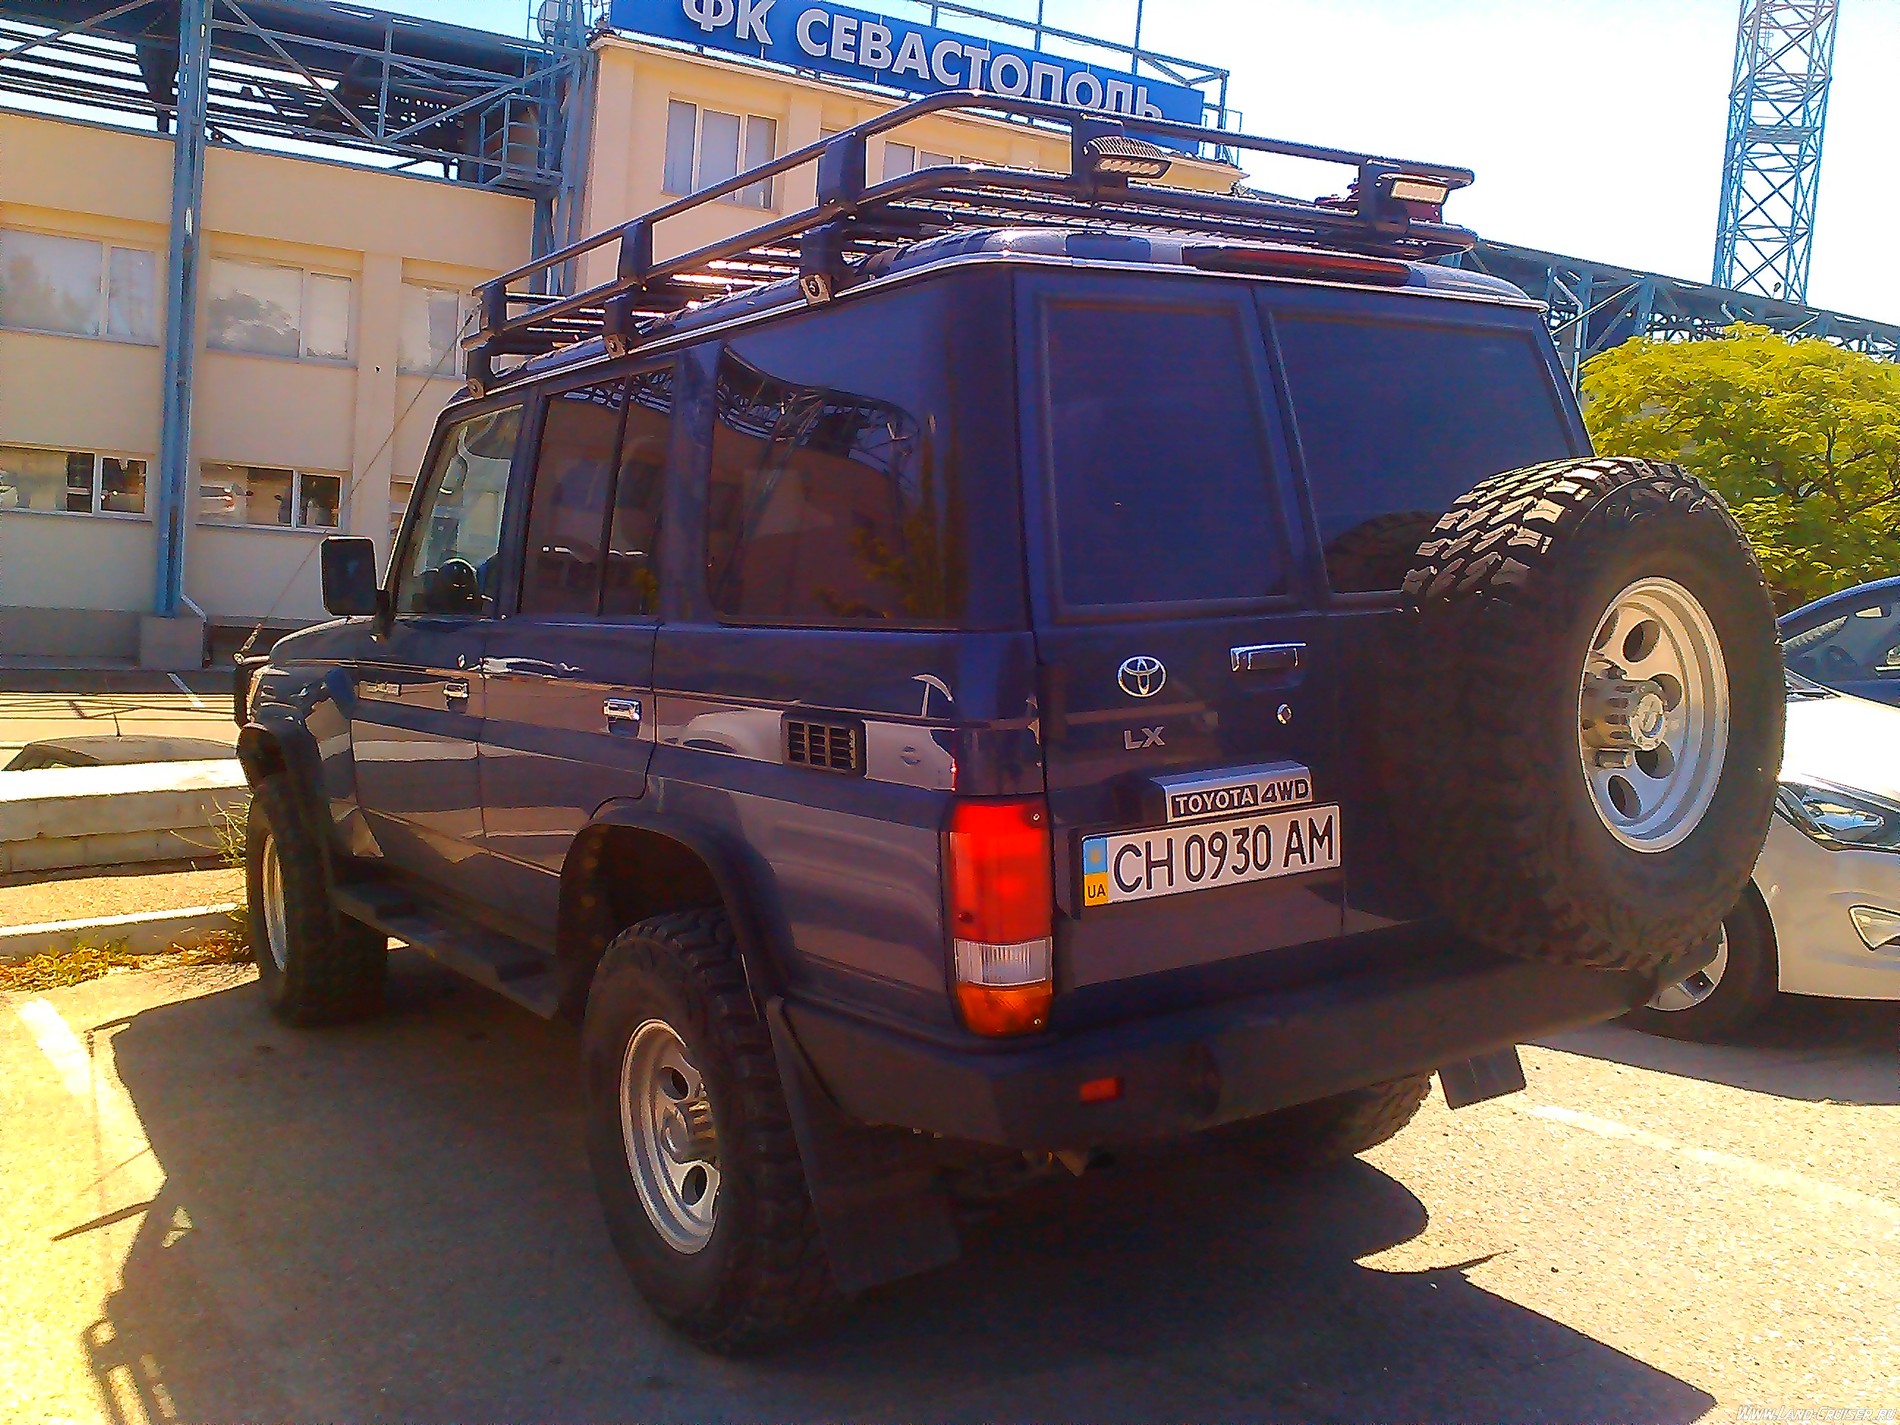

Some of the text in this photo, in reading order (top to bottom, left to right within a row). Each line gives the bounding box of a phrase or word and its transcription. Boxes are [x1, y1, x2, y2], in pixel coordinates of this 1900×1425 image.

[682, 0, 1163, 119] ФК СЕВАСТОПОЛЬ
[1124, 726, 1165, 750] LX
[1175, 779, 1309, 815] TOYOTA 4WD
[1113, 814, 1333, 893] CH 0930 AM
[1087, 883, 1107, 899] UA
